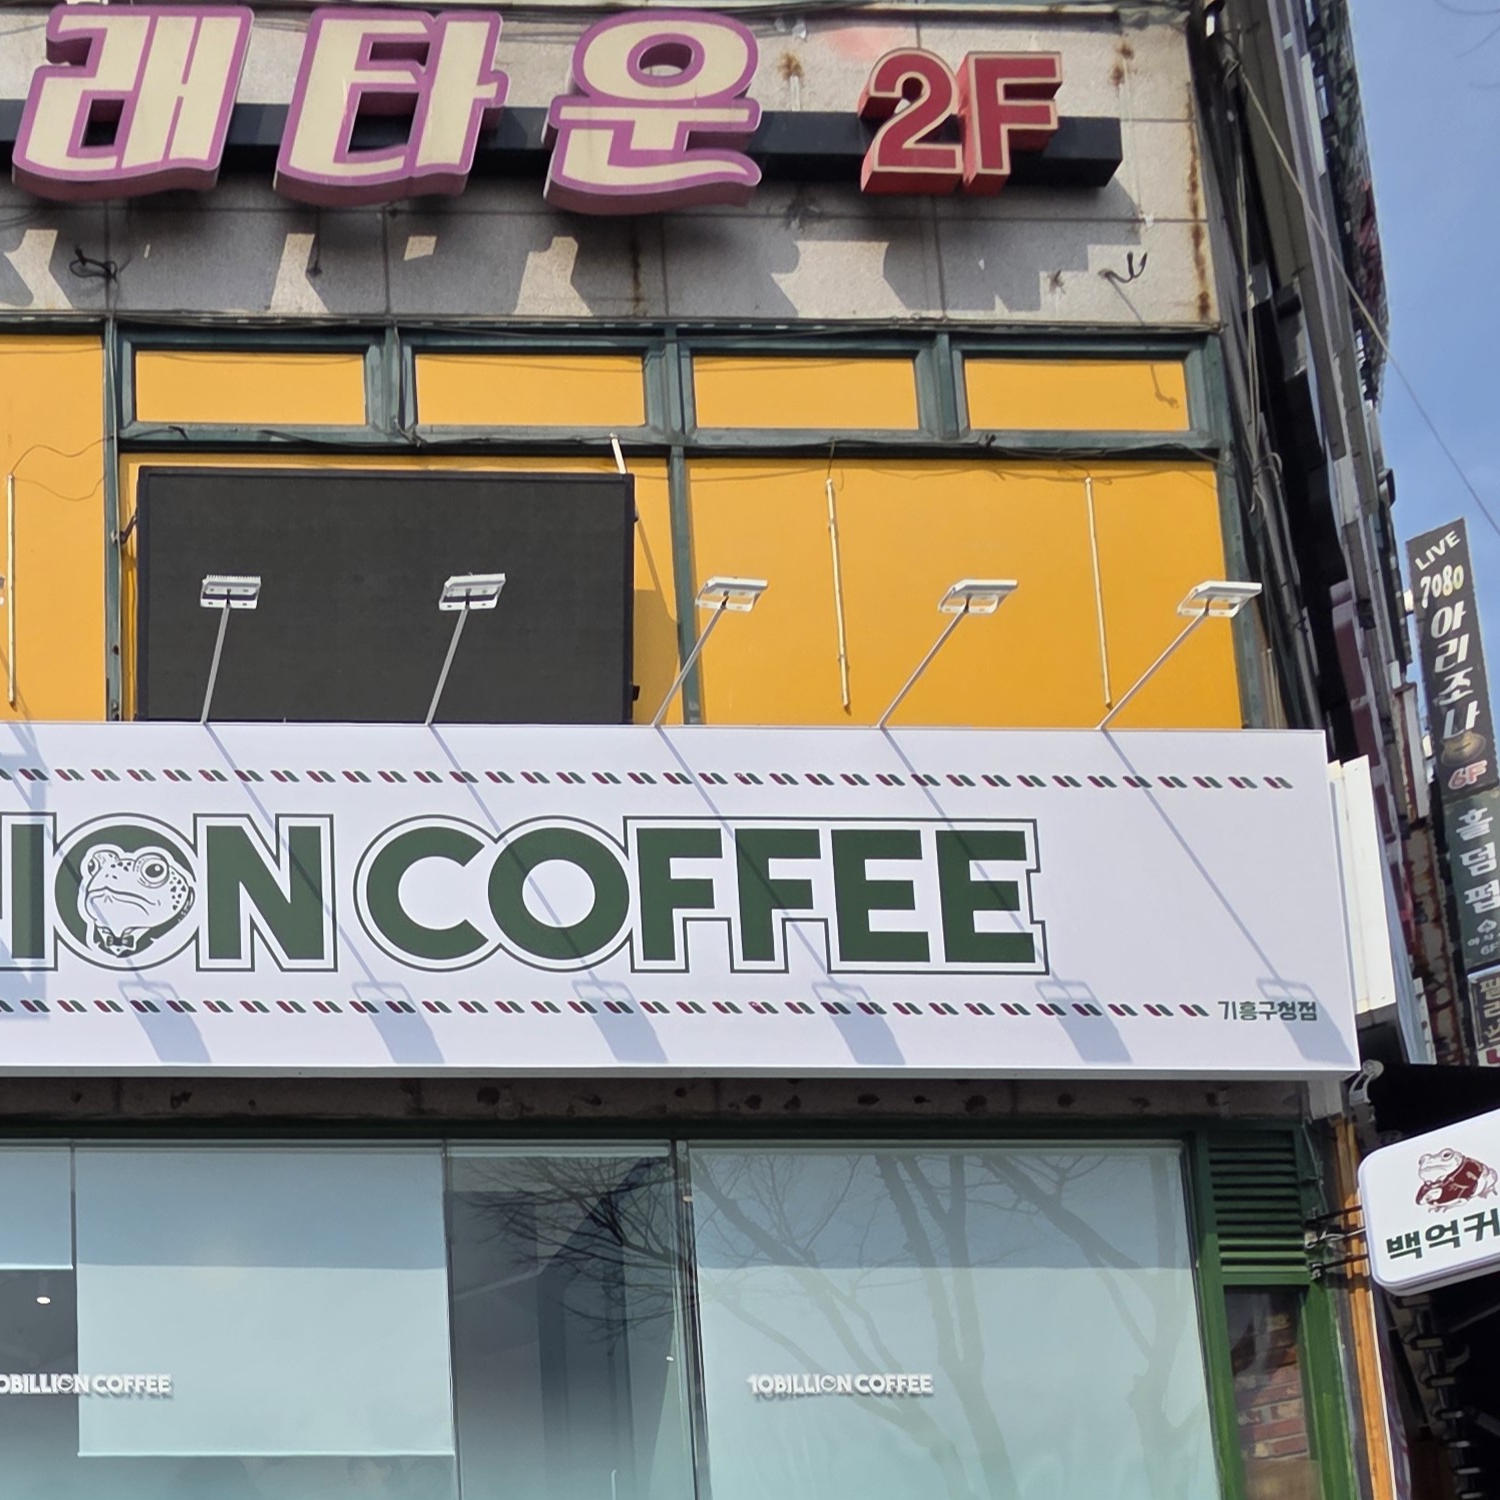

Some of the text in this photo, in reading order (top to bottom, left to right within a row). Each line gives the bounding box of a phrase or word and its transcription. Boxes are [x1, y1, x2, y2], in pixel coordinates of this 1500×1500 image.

[858, 48, 1064, 195] 2F
[1414, 530, 1461, 571] LIVE
[1420, 564, 1464, 609] 7080
[1430, 600, 1481, 740] 아리조나
[1448, 760, 1488, 790] 6F
[353, 814, 1050, 975] COFFEE
[1217, 1000, 1318, 1021] 기흥구청점
[92, 1373, 173, 1395] COFFEE
[747, 1373, 935, 1395] 10BILLION COFFEE
